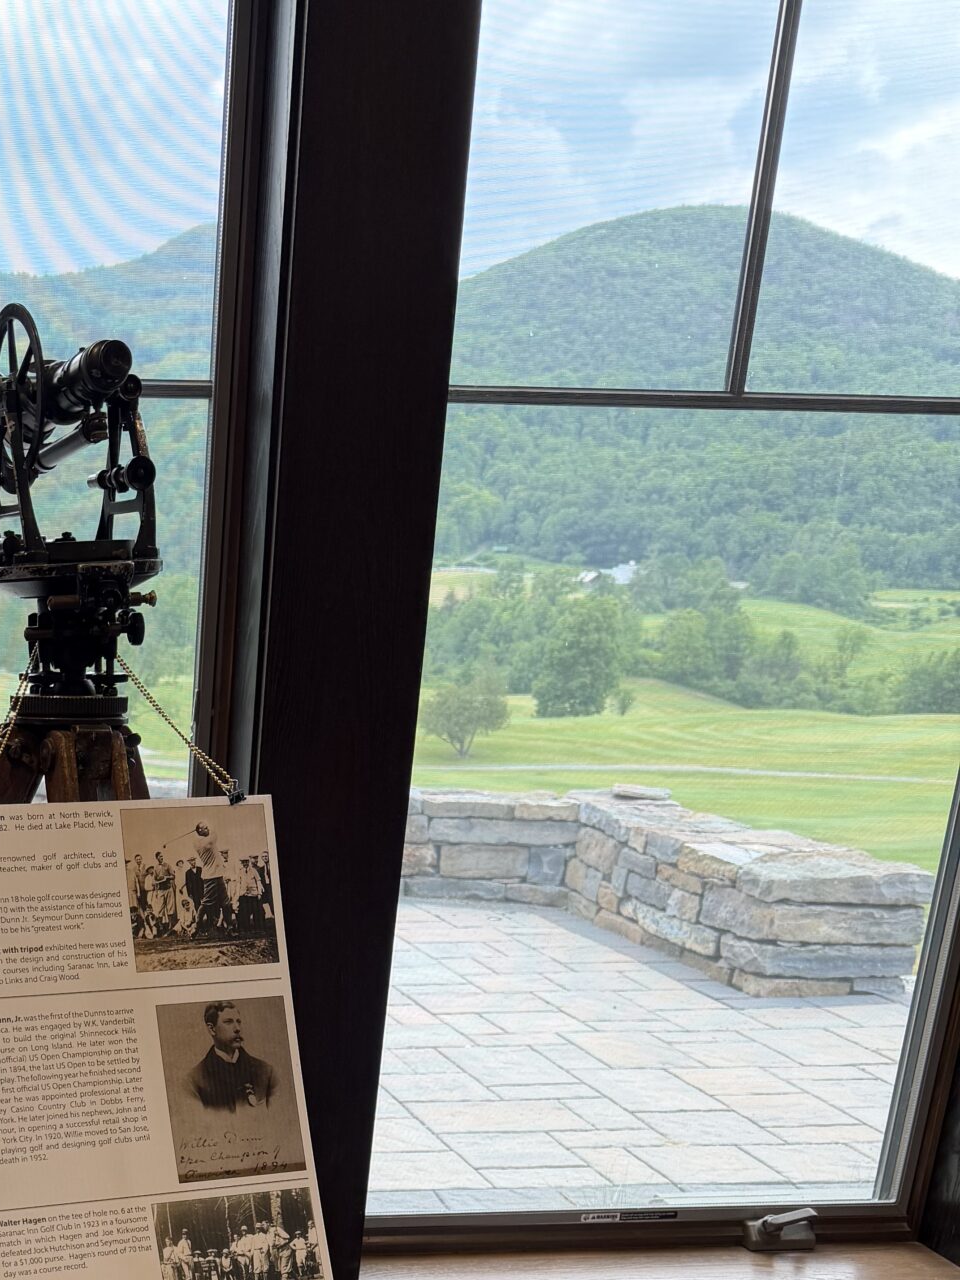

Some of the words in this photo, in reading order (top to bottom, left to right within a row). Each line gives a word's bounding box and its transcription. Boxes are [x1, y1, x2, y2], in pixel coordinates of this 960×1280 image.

[26, 812, 44, 821] born
[59, 811, 80, 819] North
[14, 823, 25, 831] He
[27, 822, 43, 831] died
[54, 821, 72, 830] Lake
[97, 820, 114, 828] New
[0, 853, 36, 863] renowned
[42, 852, 57, 862] golf
[101, 850, 117, 858] club
[30, 863, 52, 871] maker
[66, 861, 80, 871] golf
[82, 861, 102, 869] clubs
[104, 860, 118, 868] and
[10, 895, 20, 903] 18
[19, 894, 36, 902] hole
[36, 893, 50, 904] golf
[88, 890, 121, 900] designed
[0, 916, 21, 924] Dunn
[32, 914, 63, 924] Seymour
[64, 913, 84, 921] Dunn
[85, 909, 123, 920] considered
[9, 926, 19, 934] be
[20, 925, 31, 933] his
[1, 945, 20, 954] with
[19, 944, 44, 954] tripod
[44, 943, 78, 952] exhibited
[78, 942, 94, 950] here
[109, 939, 127, 948] used
[2, 967, 30, 975] courses
[32, 964, 65, 973] including
[67, 963, 94, 971] Saranac
[112, 960, 129, 968] Lake
[4, 976, 23, 985] Links
[24, 975, 38, 983] and
[38, 974, 58, 983] Craig
[12, 1025, 22, 1033] He
[40, 1021, 72, 1032] engaged
[72, 1021, 82, 1030] by
[99, 1016, 135, 1026] Vanderbilt
[28, 1053, 39, 1062] US
[40, 1053, 61, 1062] Open
[61, 1048, 112, 1060] Championship
[124, 1046, 139, 1054] that
[13, 1095, 23, 1103] he
[41, 1090, 78, 1102] appointed
[79, 1087, 121, 1099] professional
[132, 1085, 144, 1093] the
[10, 1105, 35, 1114] Casino
[37, 1103, 67, 1111] Country
[69, 1100, 87, 1108] Club
[100, 1097, 124, 1106] Dobbs
[21, 1217, 47, 1226] Hagen
[92, 1209, 108, 1217] hole
[134, 1205, 147, 1213] the
[0, 1238, 22, 1248] match
[34, 1235, 57, 1244] which
[58, 1233, 83, 1242] Hagen
[85, 1230, 99, 1239] and
[101, 1229, 114, 1237] Joe
[116, 1224, 150, 1235] Kirkwood
[0, 1247, 33, 1258] defeated
[33, 1245, 49, 1255] Jock
[49, 1243, 85, 1252] Hutchison
[86, 1239, 100, 1249] and
[99, 1238, 131, 1248] Seymour
[131, 1235, 151, 1243] Dunn
[3, 1270, 17, 1279] day
[38, 1266, 62, 1274] course
[63, 1261, 88, 1271] record.
